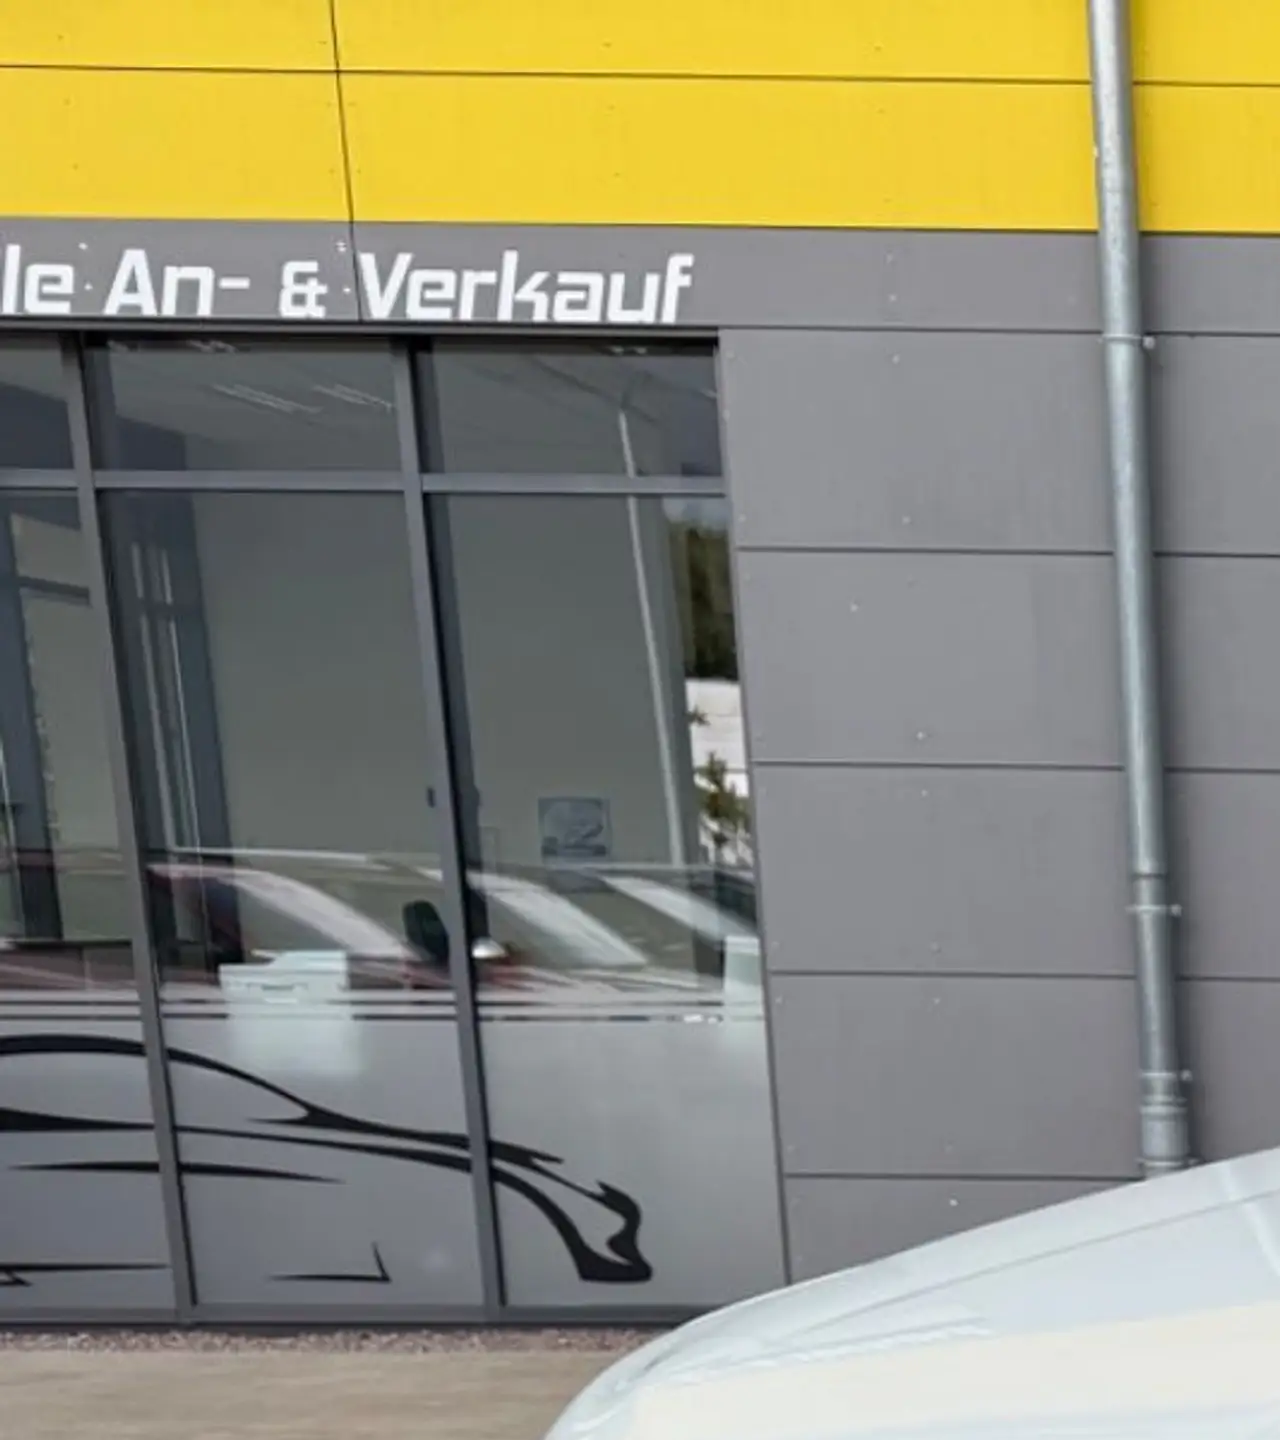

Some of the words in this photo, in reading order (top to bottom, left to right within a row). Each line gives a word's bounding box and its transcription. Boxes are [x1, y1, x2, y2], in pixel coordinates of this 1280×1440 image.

[103, 248, 251, 317] An-
[278, 259, 328, 319] &
[358, 249, 695, 324] Verkauf
